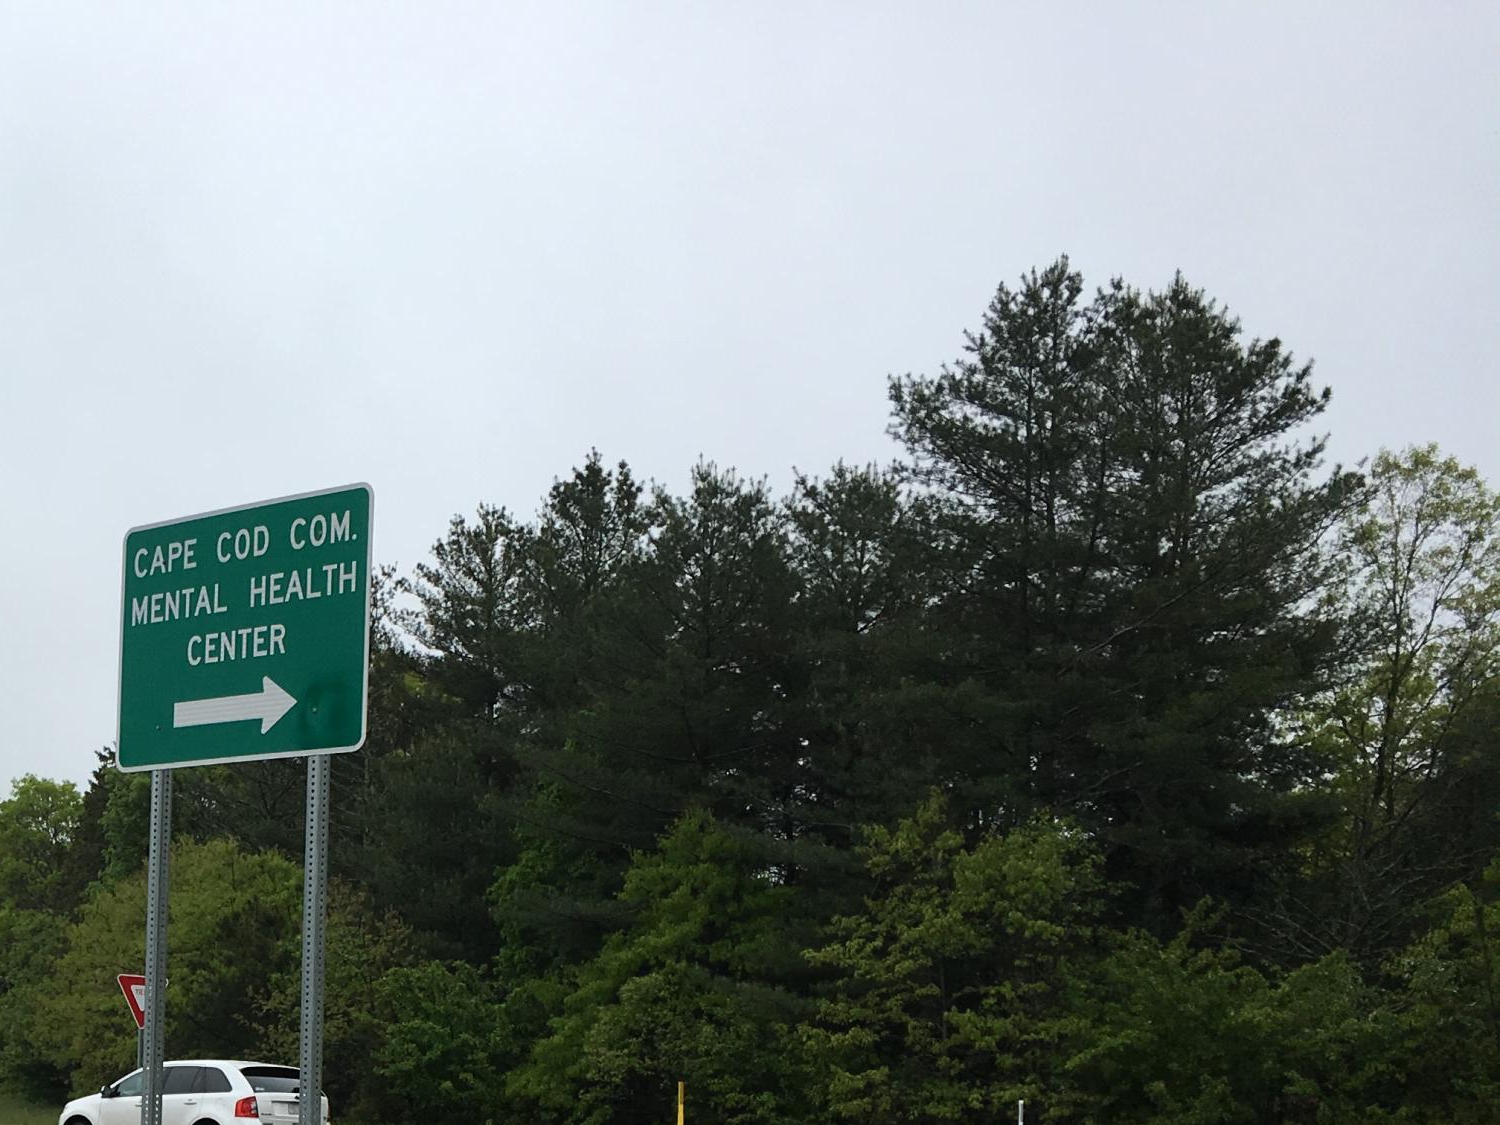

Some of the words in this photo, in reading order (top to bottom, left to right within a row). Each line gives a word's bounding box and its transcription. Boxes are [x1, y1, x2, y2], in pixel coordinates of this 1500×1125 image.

[134, 538, 198, 578] CAPE
[217, 525, 269, 563] COD
[290, 510, 357, 550] COM.
[131, 583, 228, 626] MENTAL
[250, 561, 357, 608] HEALTH
[187, 624, 286, 666] CENTER
